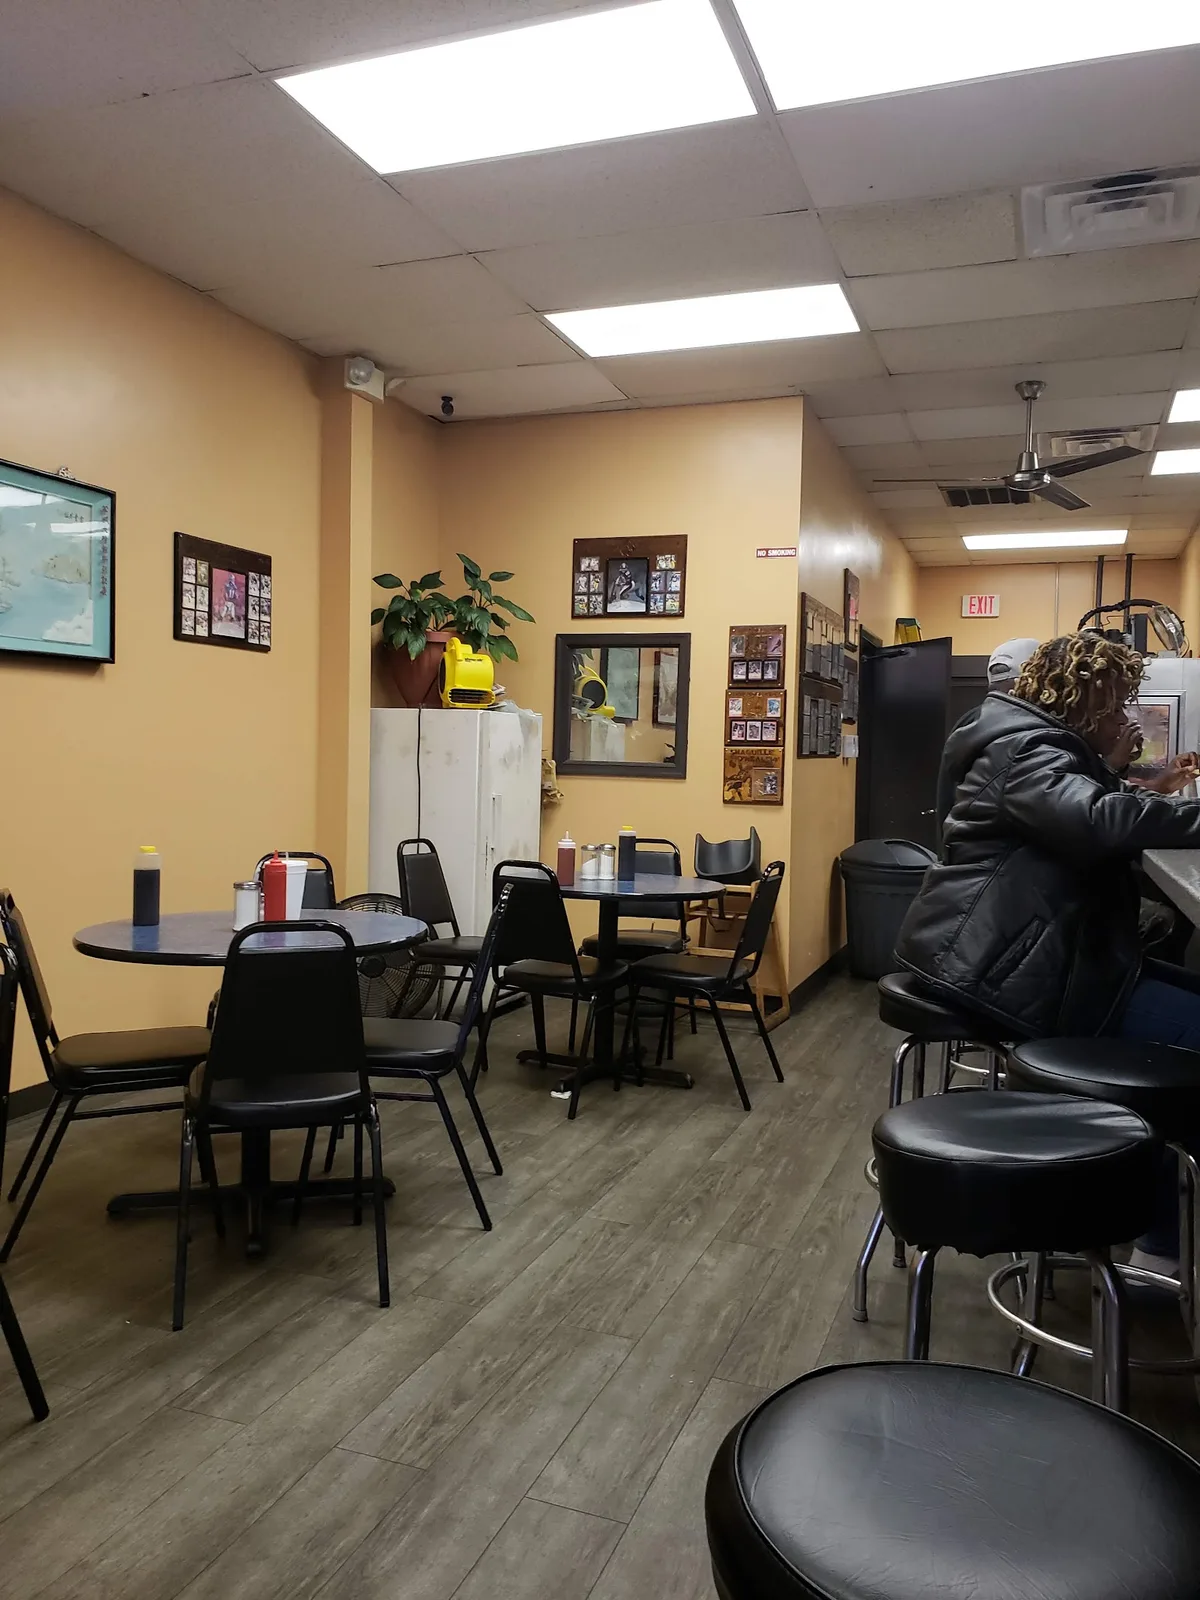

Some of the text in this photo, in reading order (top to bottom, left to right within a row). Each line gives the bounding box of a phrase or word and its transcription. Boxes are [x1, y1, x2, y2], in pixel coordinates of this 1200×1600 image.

[757, 548, 796, 557] NO SMOKING
[969, 595, 995, 615] EXIT
